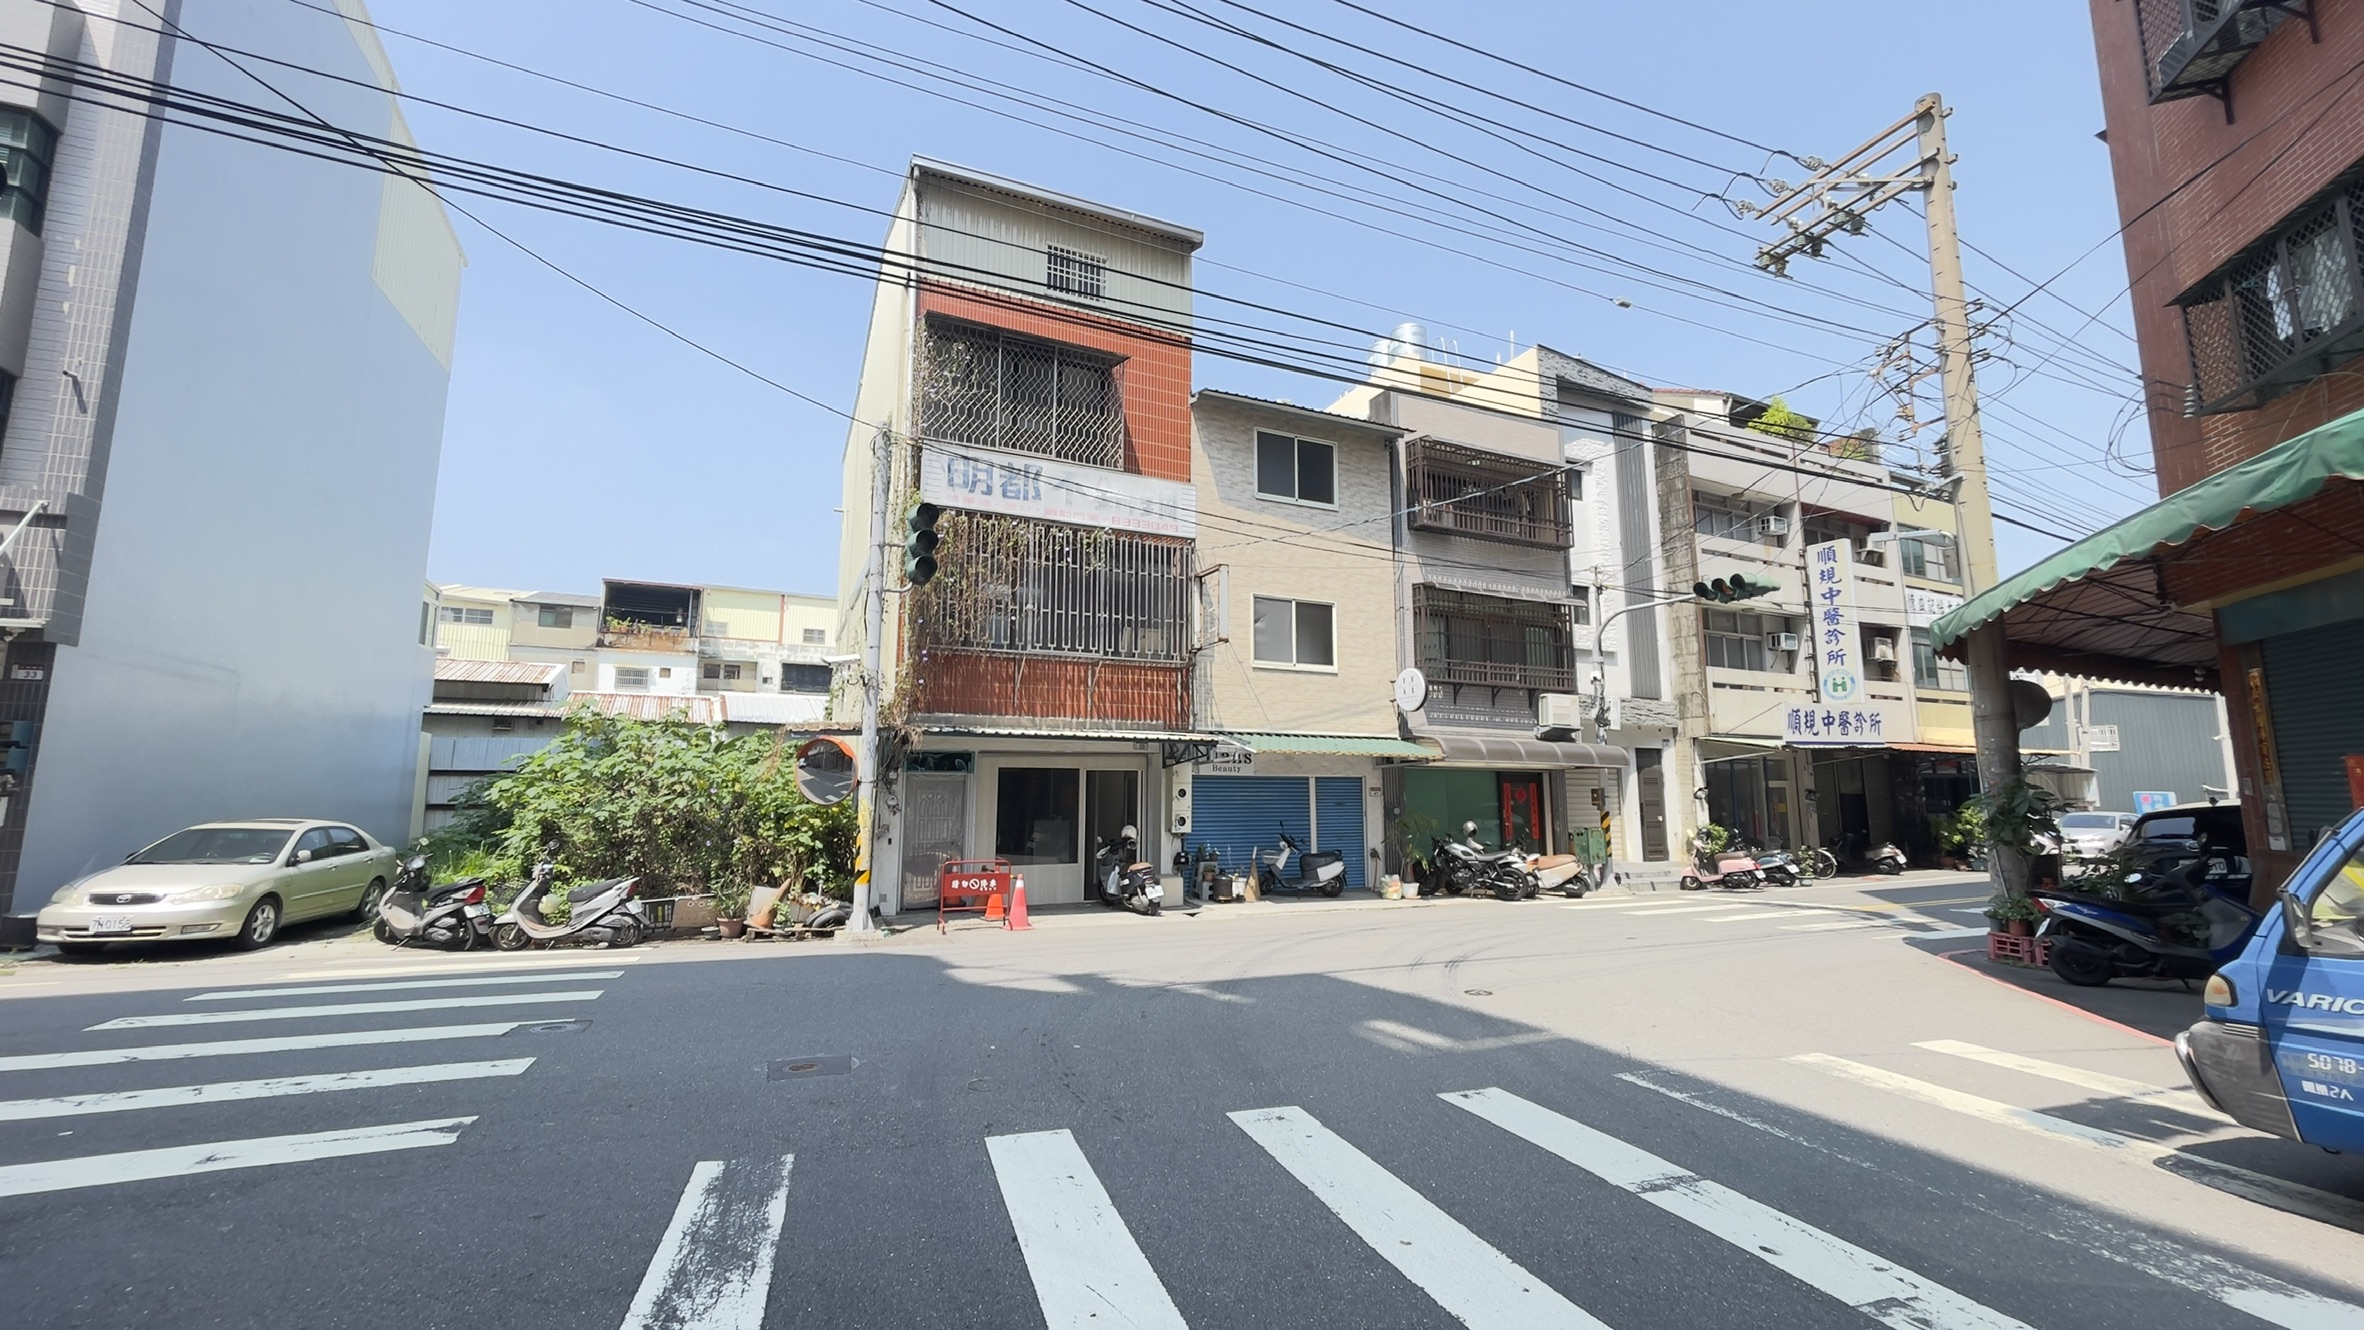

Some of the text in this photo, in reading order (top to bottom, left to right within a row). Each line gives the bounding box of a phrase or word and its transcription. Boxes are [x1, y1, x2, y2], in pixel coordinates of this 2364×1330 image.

[1816, 545, 1847, 667] 順規中醫診所
[1787, 708, 1882, 737] 順規中醫診所
[1212, 764, 1242, 773] Beauty
